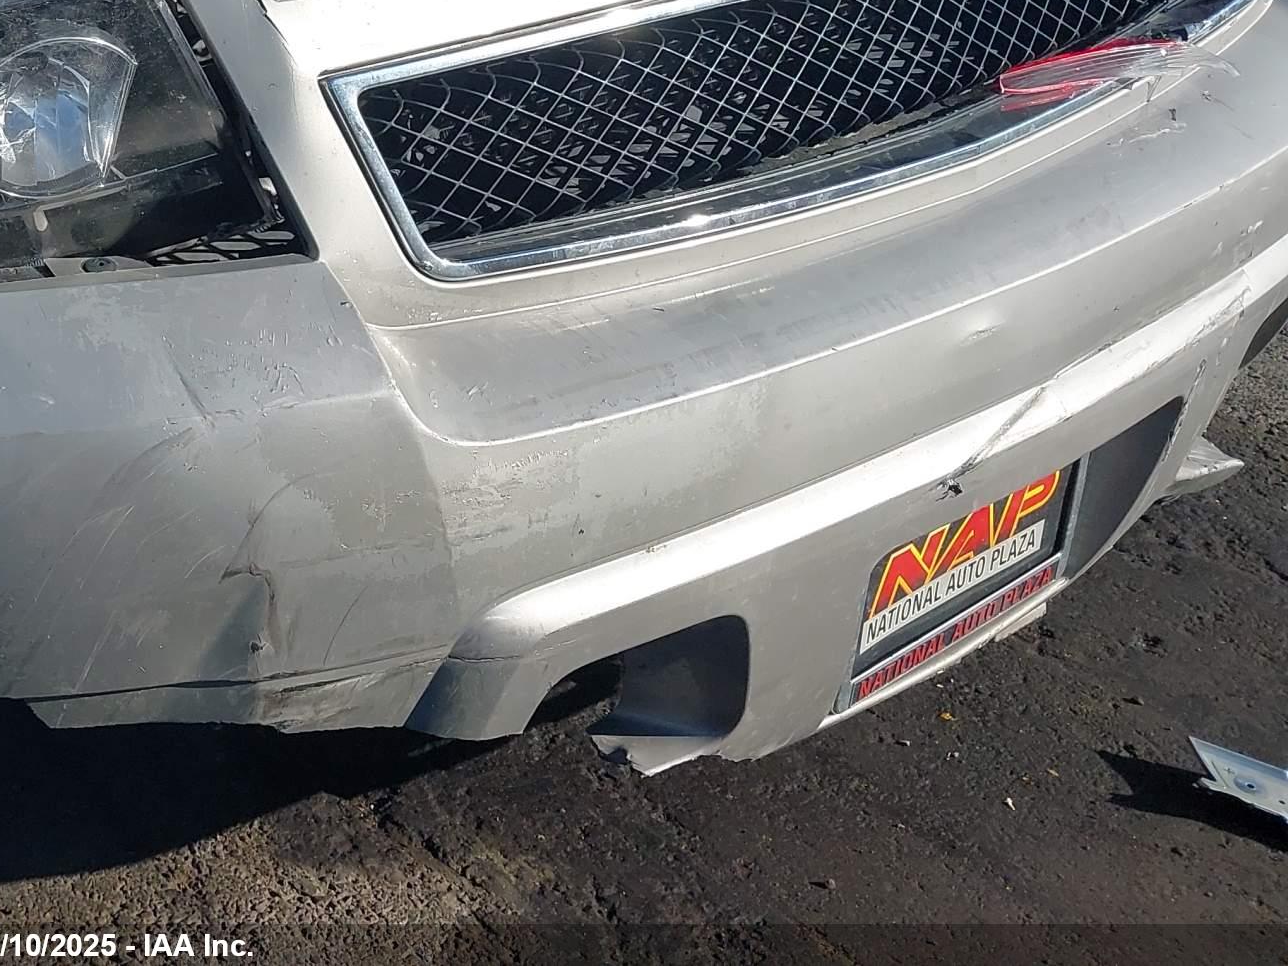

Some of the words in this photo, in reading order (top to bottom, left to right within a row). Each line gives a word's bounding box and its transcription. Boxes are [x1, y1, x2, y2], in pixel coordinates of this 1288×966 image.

[865, 590, 943, 645] NATIONAL
[944, 556, 987, 596] AUTO
[989, 528, 1036, 571] PLAZA
[868, 470, 1061, 620] NAP
[857, 633, 947, 701] NATIONAL
[951, 599, 999, 643] AUTO
[999, 565, 1054, 612] PLAZA
